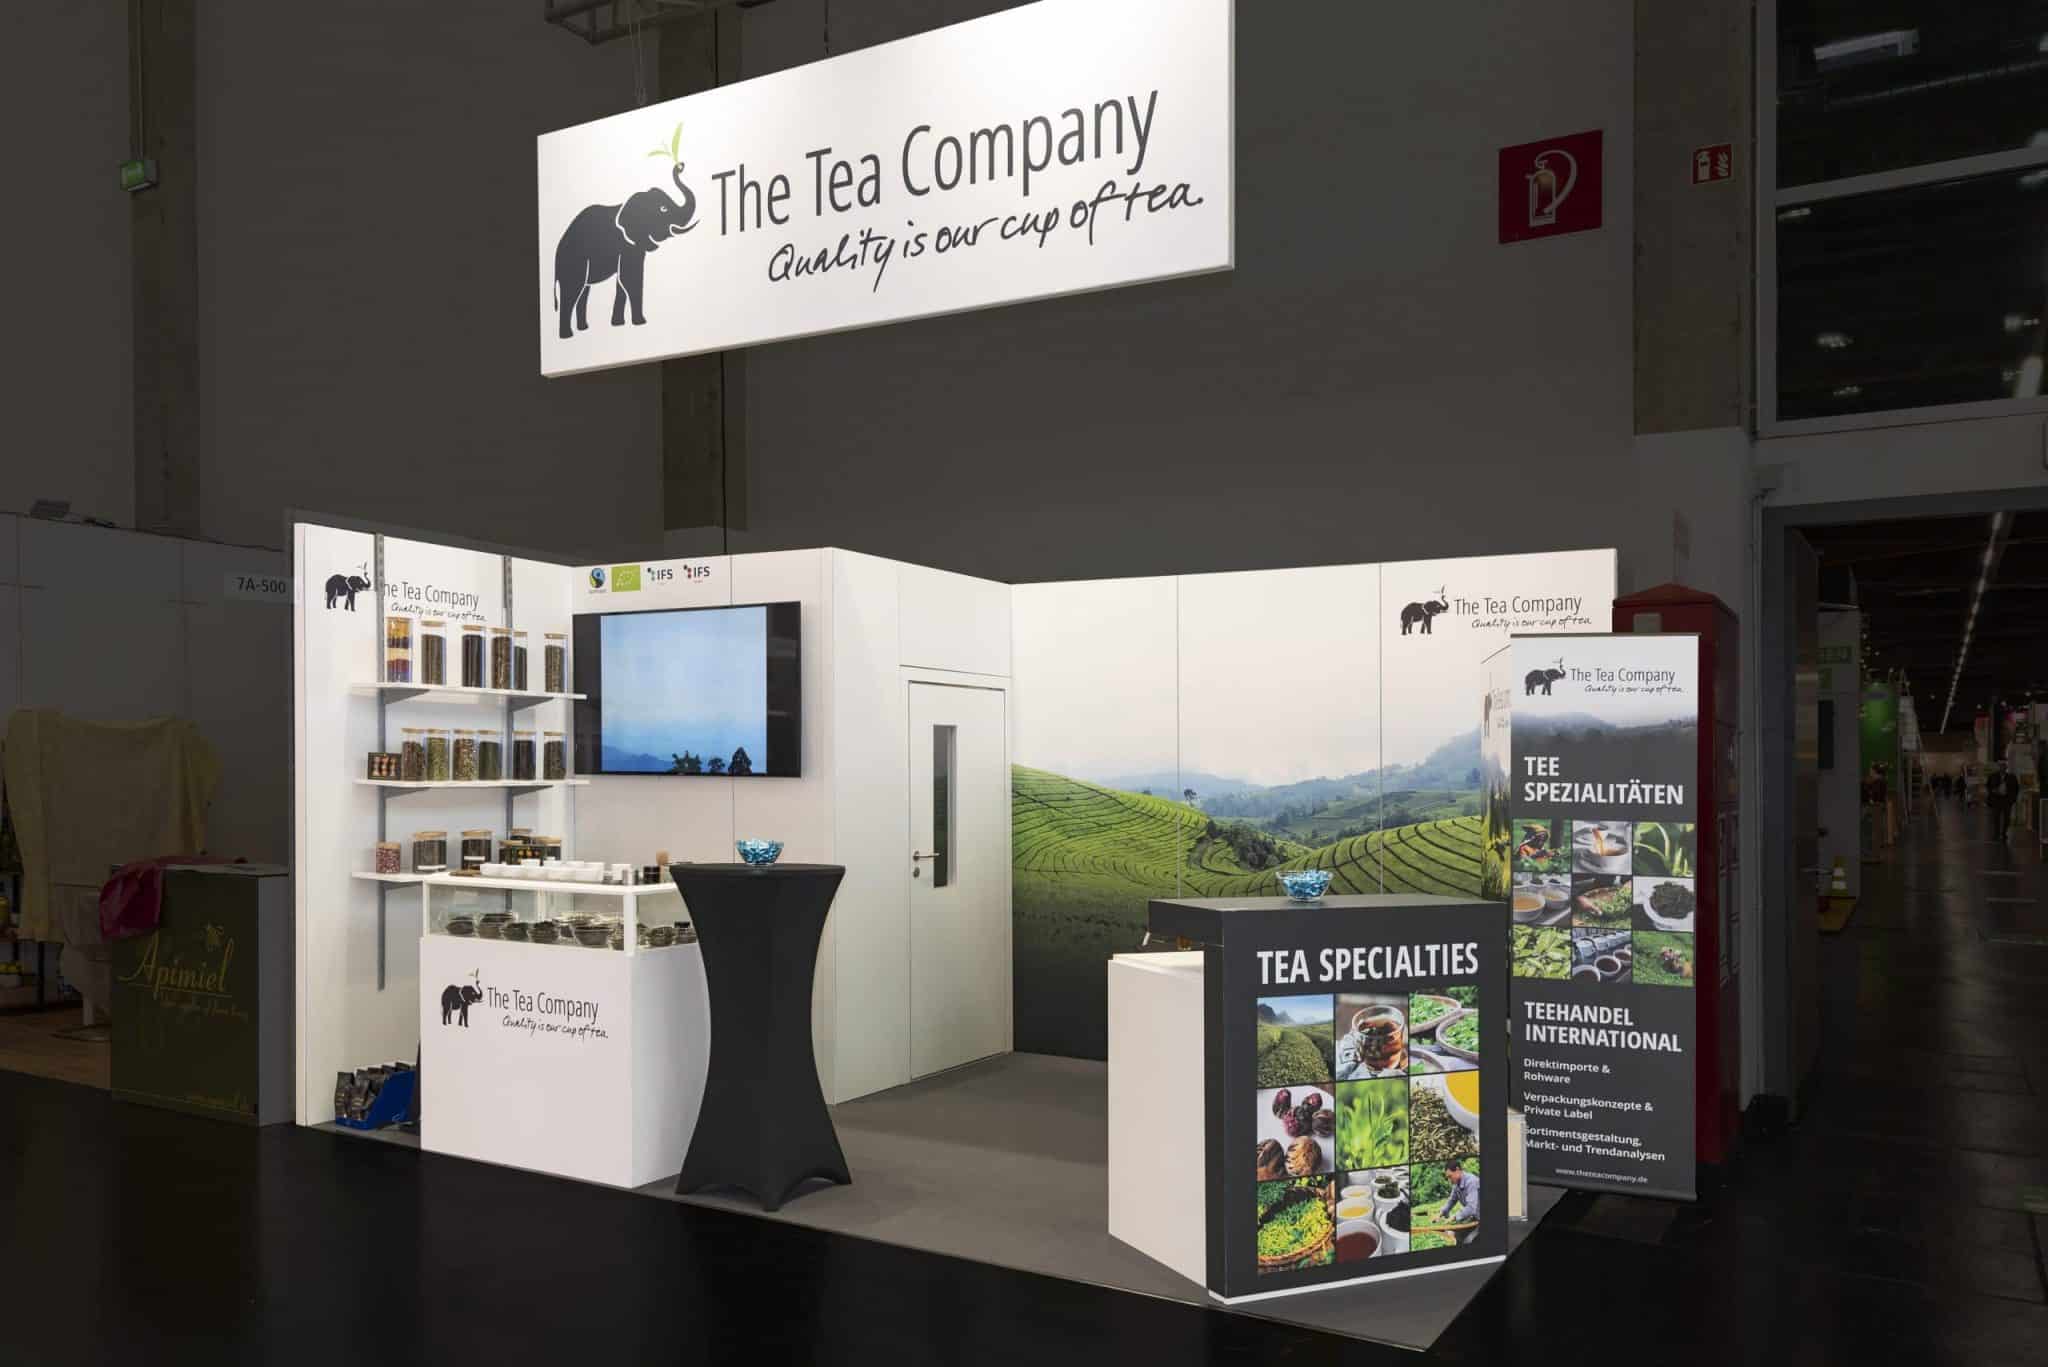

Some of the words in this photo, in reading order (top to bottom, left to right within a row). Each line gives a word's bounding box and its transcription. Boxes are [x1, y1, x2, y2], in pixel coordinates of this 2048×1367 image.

[712, 163, 790, 236] The
[806, 147, 881, 217] Tea
[901, 90, 1158, 198] Company
[768, 228, 895, 292] Quality
[904, 221, 926, 258] is
[935, 215, 1000, 254] our
[1001, 208, 1059, 248] cup
[1071, 180, 1117, 245] of
[656, 568, 673, 580] IFS
[694, 566, 710, 578] IFS
[236, 577, 286, 593] 7A-500
[401, 581, 421, 600] Tea
[425, 585, 479, 611] Company
[1454, 598, 1480, 616] The
[1484, 597, 1507, 614] Tea
[1512, 595, 1582, 617] Company
[1570, 668, 1592, 682] The
[1594, 668, 1614, 682] Tea
[1618, 668, 1676, 684] Company
[1524, 756, 1560, 776] TEE
[1524, 779, 1684, 805] SPEZIALITÄTEN
[1257, 950, 1311, 985] TEA
[1319, 942, 1479, 983] SPECIALTIES
[487, 986, 509, 1009] The
[512, 989, 533, 1012] Tea
[537, 992, 598, 1025] Company
[1524, 1001, 1634, 1026] TEEHANDEL
[1525, 1024, 1682, 1052] INTERNATIONAL
[1524, 1058, 1599, 1074] Direktimporte
[1602, 1064, 1611, 1074] &
[1524, 1071, 1571, 1084] Rohware
[1524, 1092, 1642, 1112] Verpackungskonzepte
[1644, 1102, 1654, 1112] &
[1524, 1105, 1561, 1118] Private
[1564, 1108, 1593, 1120] Label
[1562, 1144, 1582, 1153] und
[1586, 1144, 1665, 1161] Trendanalysen
